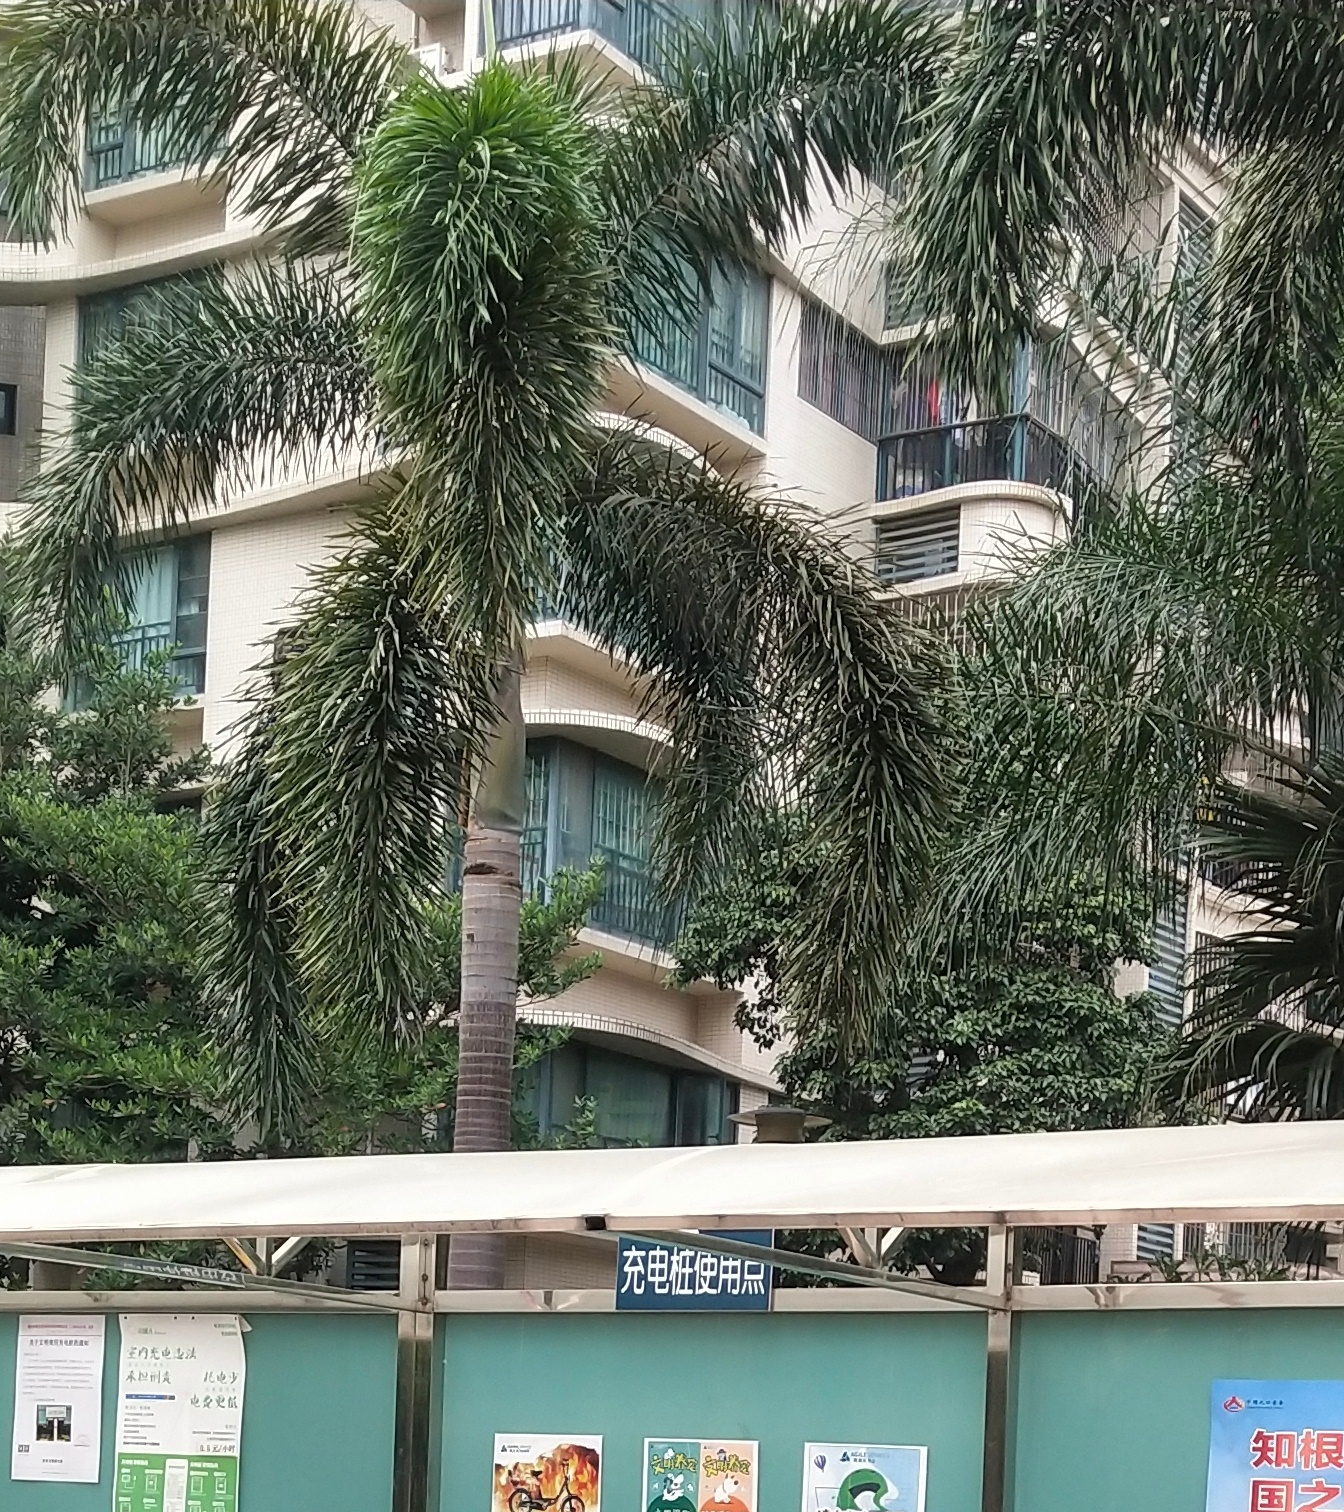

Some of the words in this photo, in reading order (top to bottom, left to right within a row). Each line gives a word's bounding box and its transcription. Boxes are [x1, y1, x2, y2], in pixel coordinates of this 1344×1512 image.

[620, 1245, 765, 1295] 充电桩使用点
